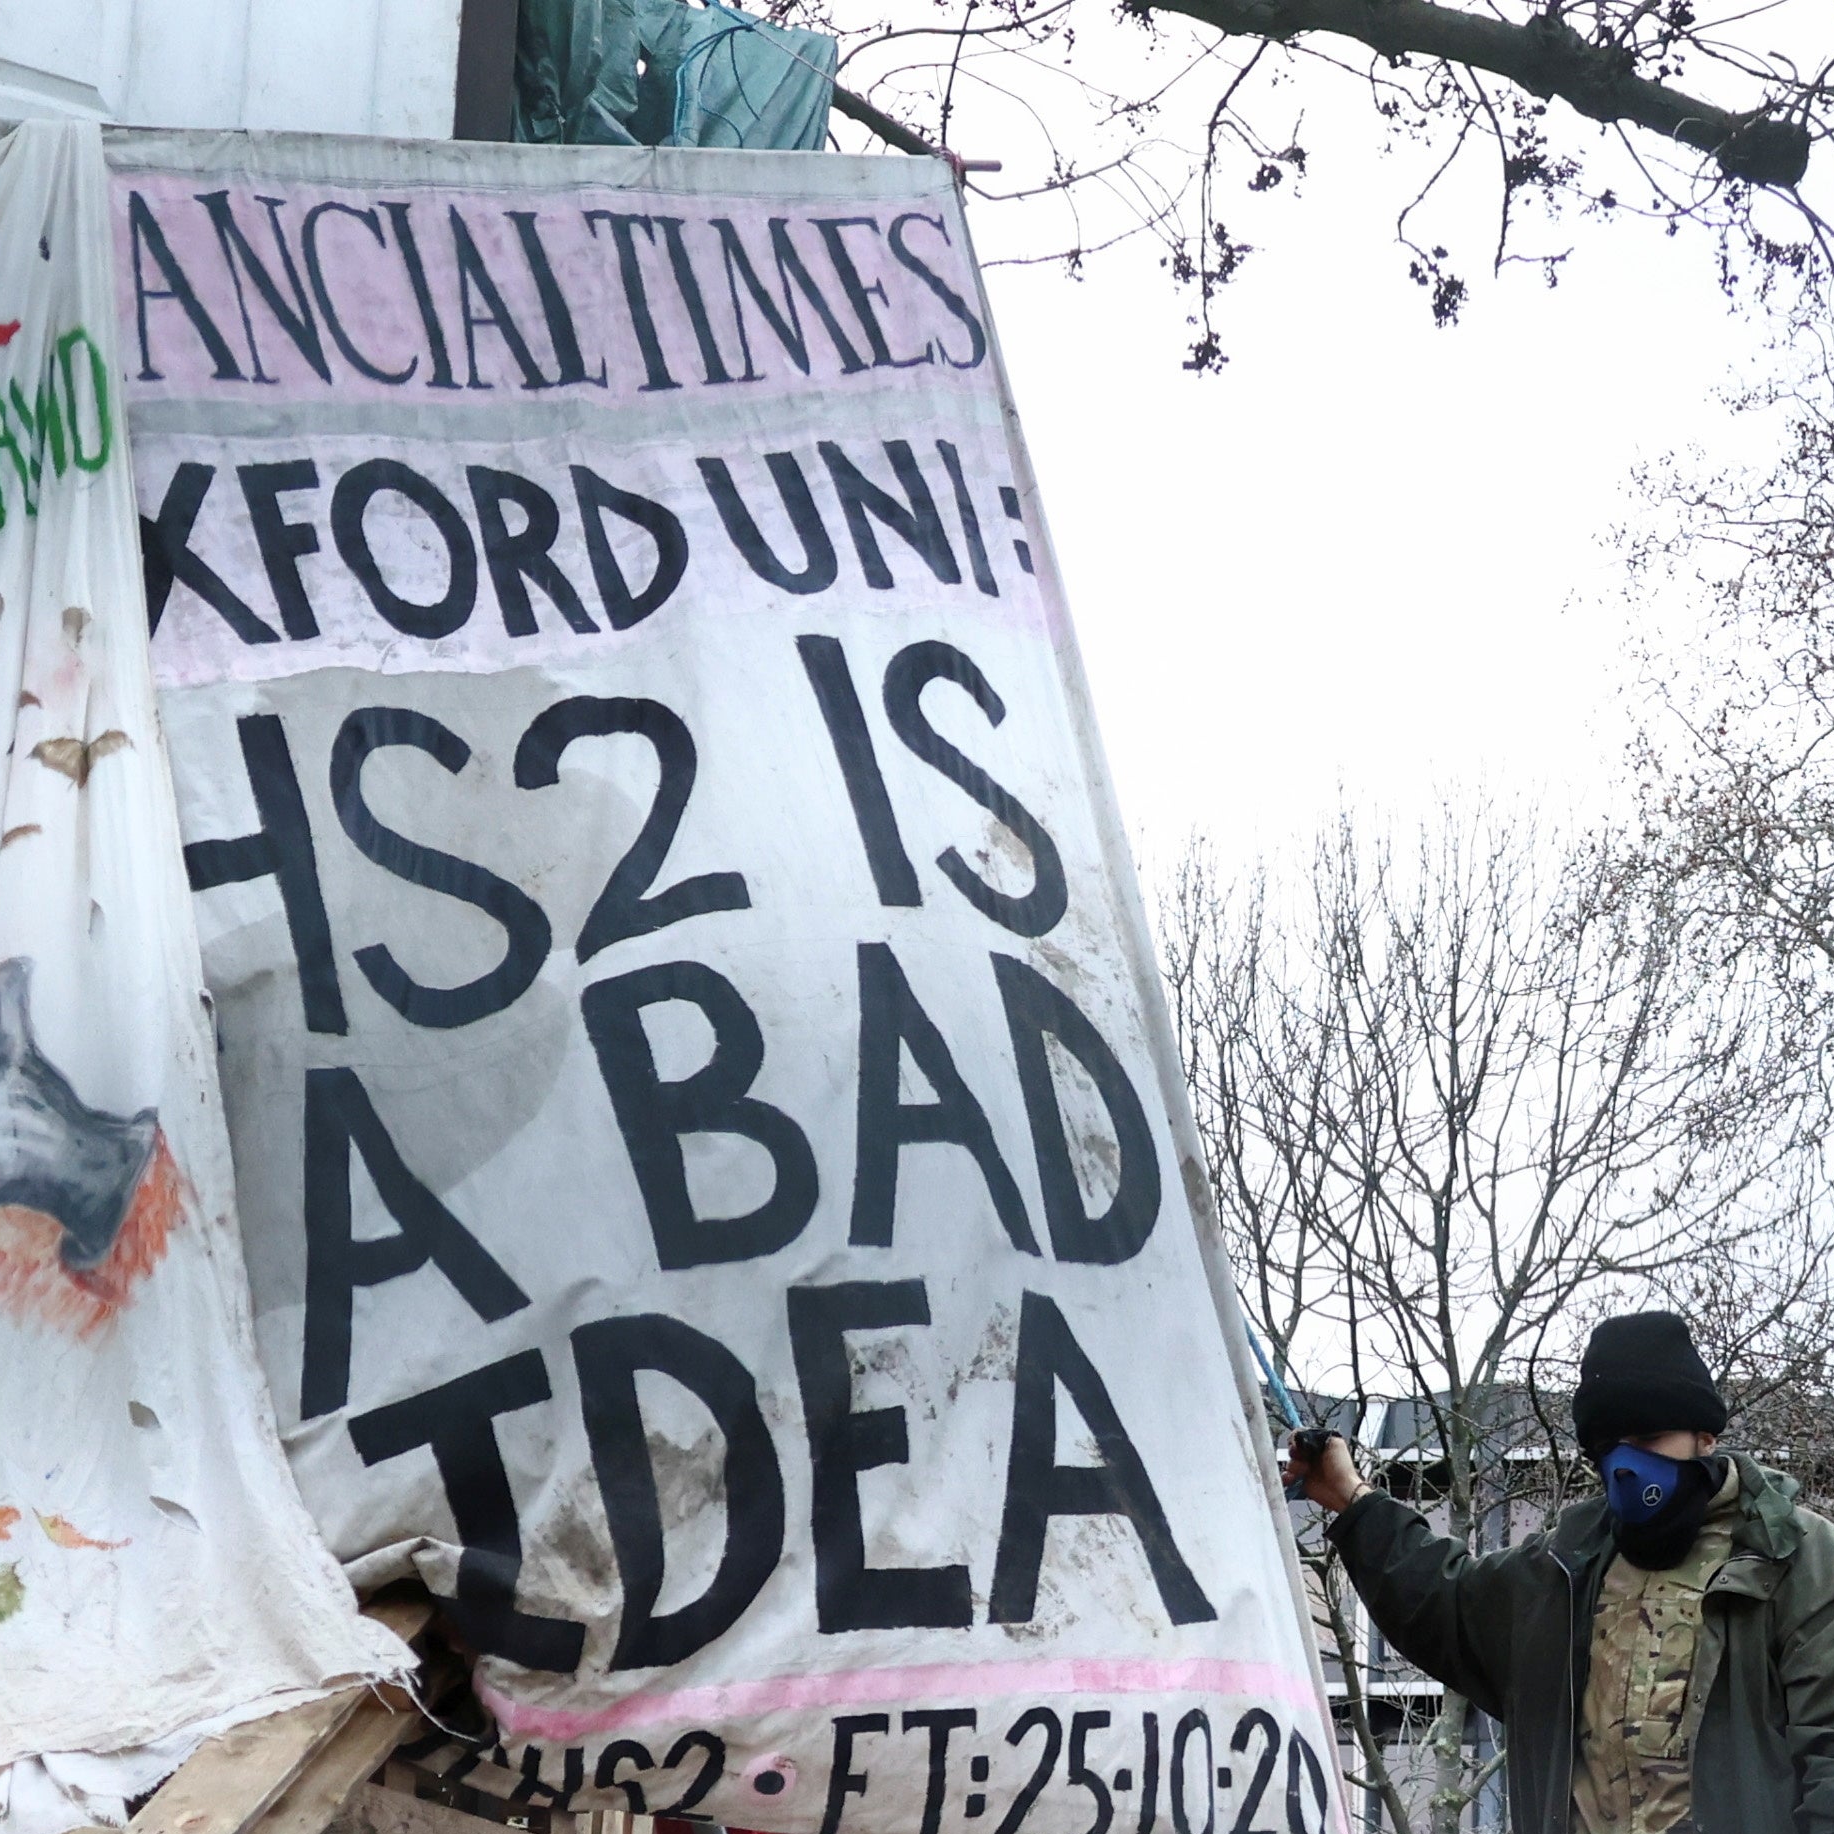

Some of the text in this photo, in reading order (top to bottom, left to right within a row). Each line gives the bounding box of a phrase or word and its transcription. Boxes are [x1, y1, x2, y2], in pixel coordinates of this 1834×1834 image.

[125, 190, 989, 392] ANCIAL TIMES
[795, 632, 1071, 940] IS
[301, 941, 1163, 1421] A BAD
[347, 1278, 1219, 1676] IDEA
